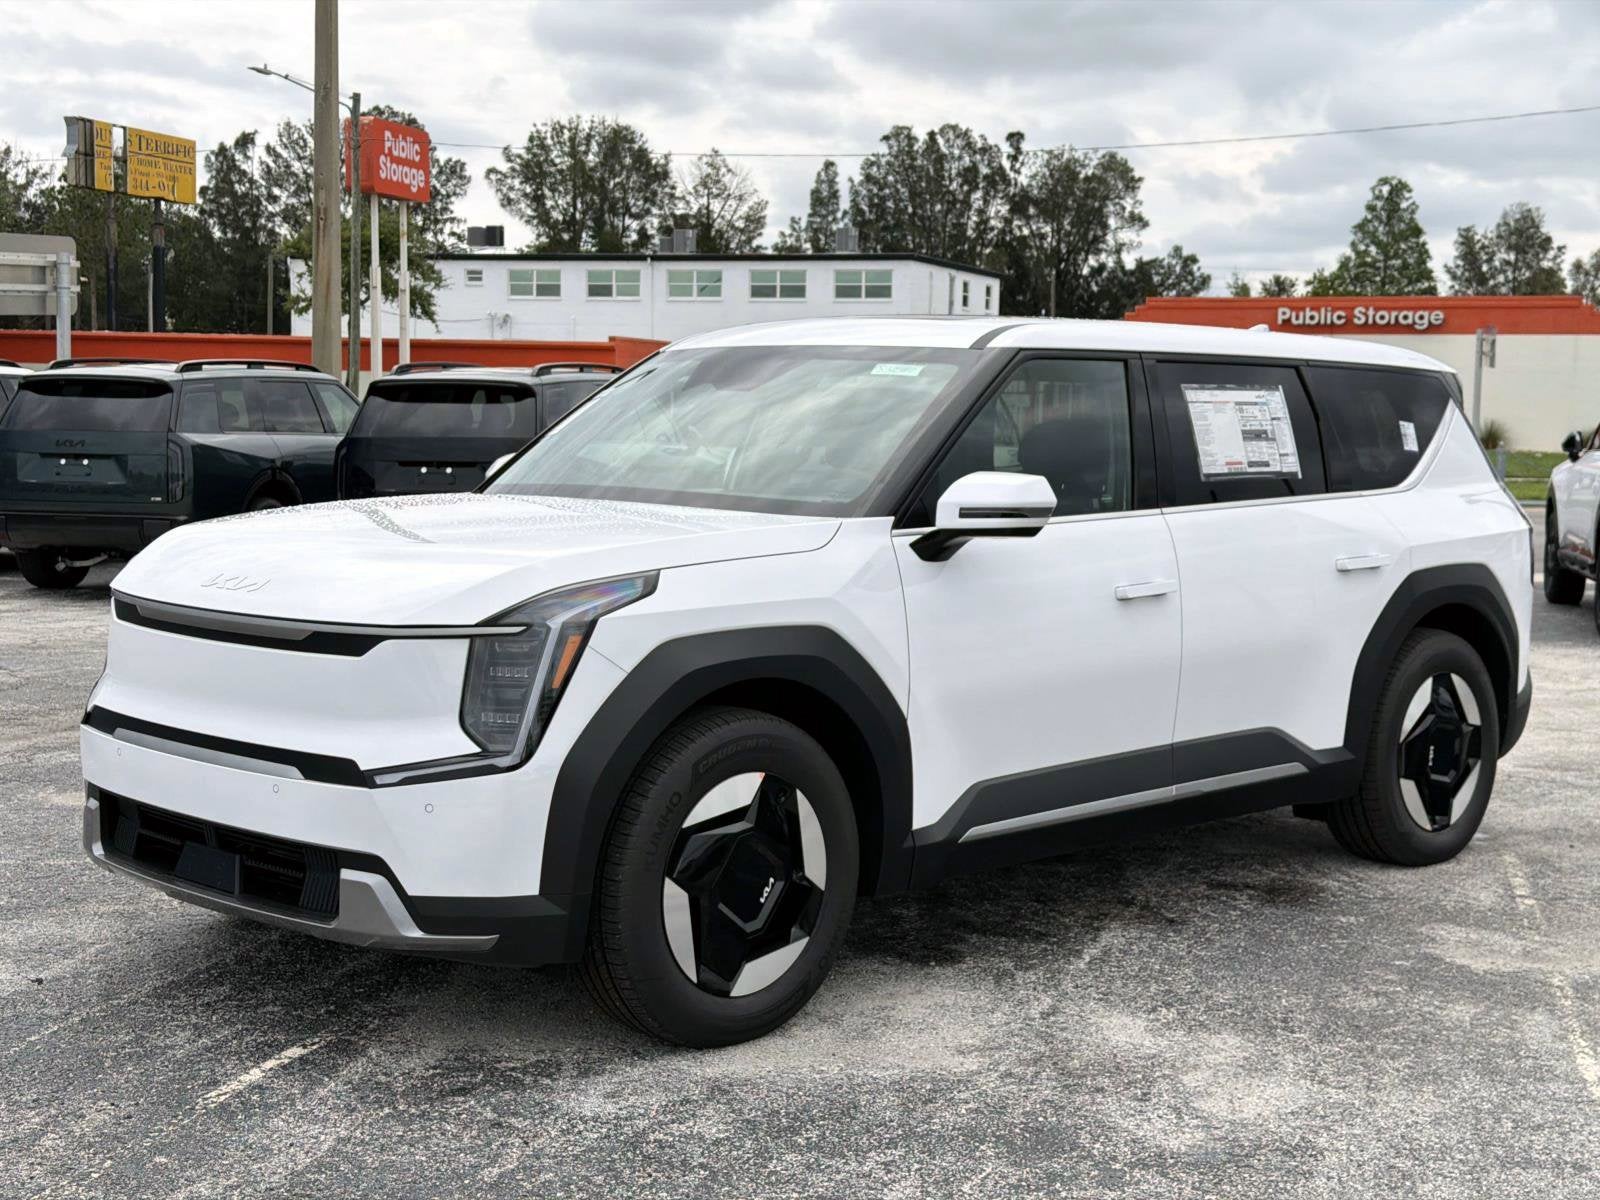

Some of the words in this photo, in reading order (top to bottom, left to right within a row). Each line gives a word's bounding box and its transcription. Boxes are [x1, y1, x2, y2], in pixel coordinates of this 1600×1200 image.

[136, 134, 194, 161] TERRIFIC
[384, 130, 421, 162] Public
[379, 154, 425, 193] Storage
[1277, 307, 1347, 325] Public
[1353, 306, 1444, 330] Storage
[200, 572, 272, 593] KIA
[759, 876, 775, 904] KIA
